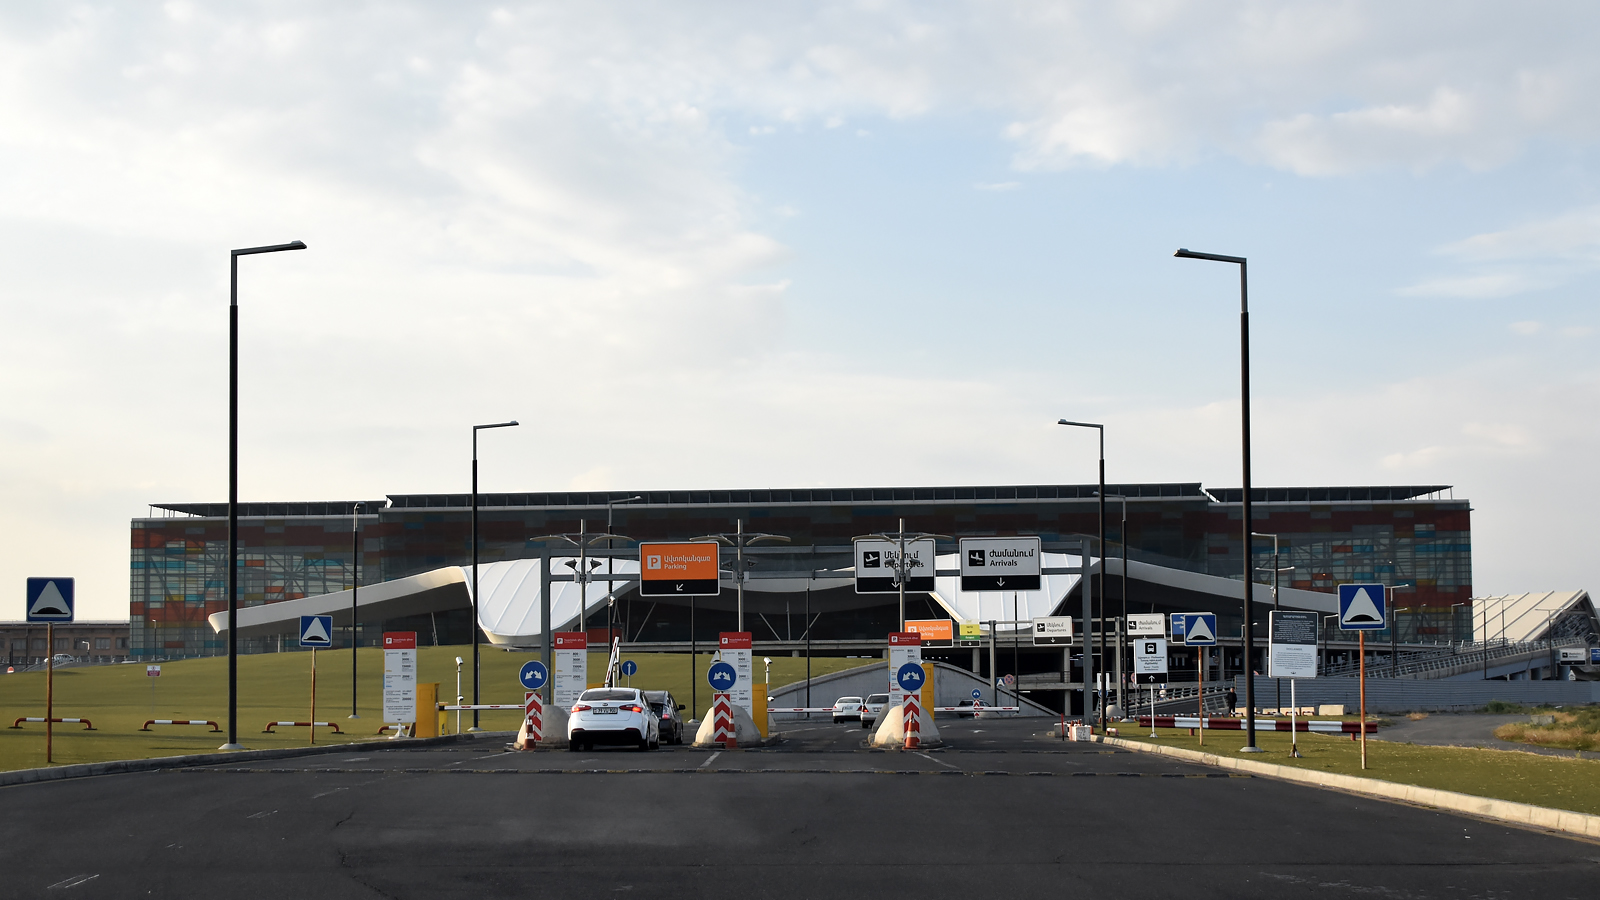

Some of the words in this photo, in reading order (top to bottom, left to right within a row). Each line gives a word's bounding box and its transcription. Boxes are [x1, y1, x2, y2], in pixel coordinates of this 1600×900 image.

[664, 555, 710, 563] Ավտոկանգառ
[884, 550, 919, 560] Մեկում
[651, 557, 658, 567] P
